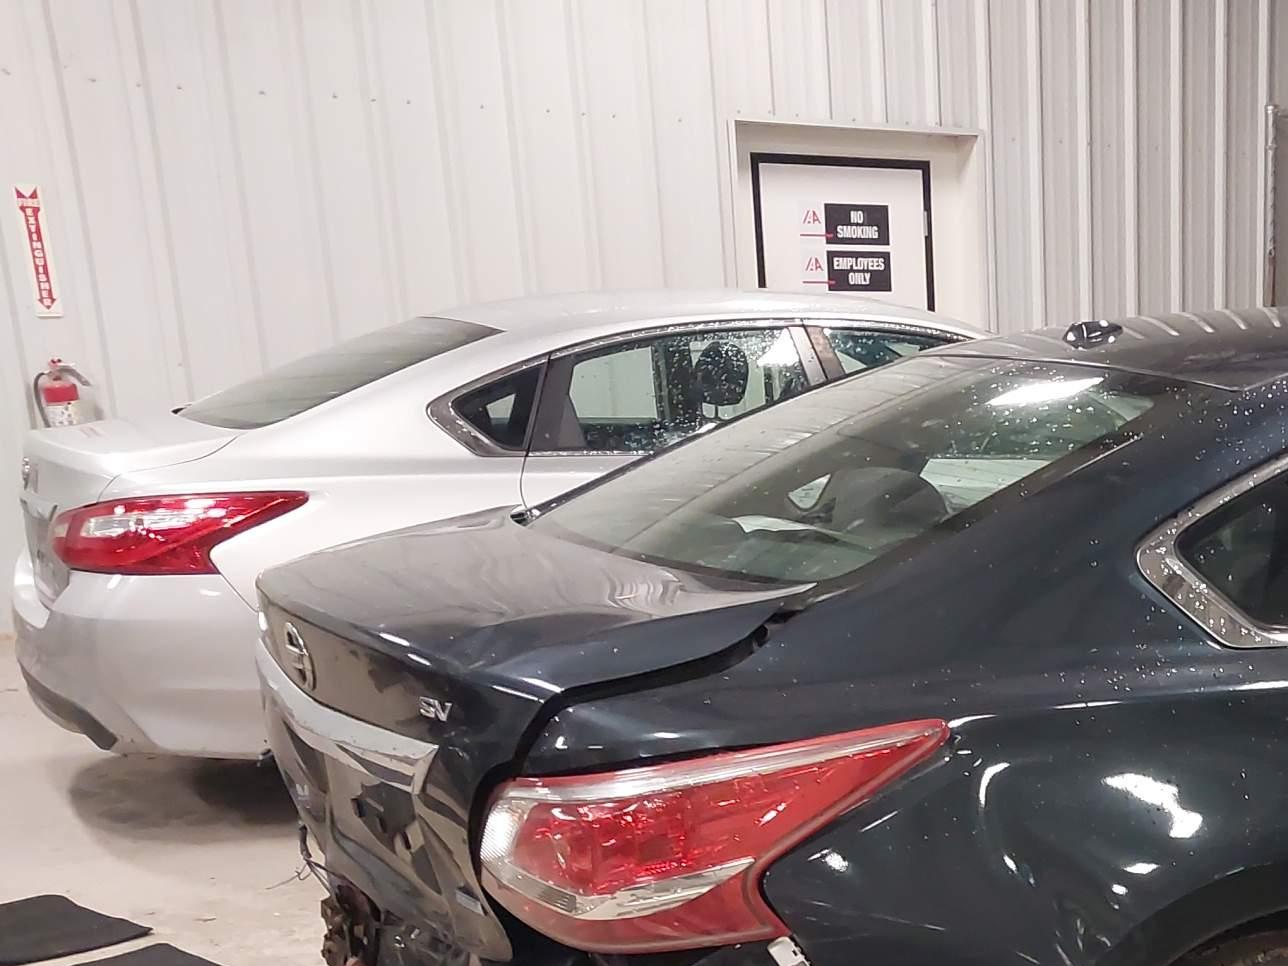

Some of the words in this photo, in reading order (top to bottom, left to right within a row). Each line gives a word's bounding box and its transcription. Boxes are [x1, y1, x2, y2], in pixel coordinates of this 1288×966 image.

[850, 211, 864, 223] NO
[837, 225, 878, 238] SMOKING
[833, 257, 884, 270] EMPLOYEES
[848, 272, 871, 285] ONLY
[418, 696, 453, 722] SV
